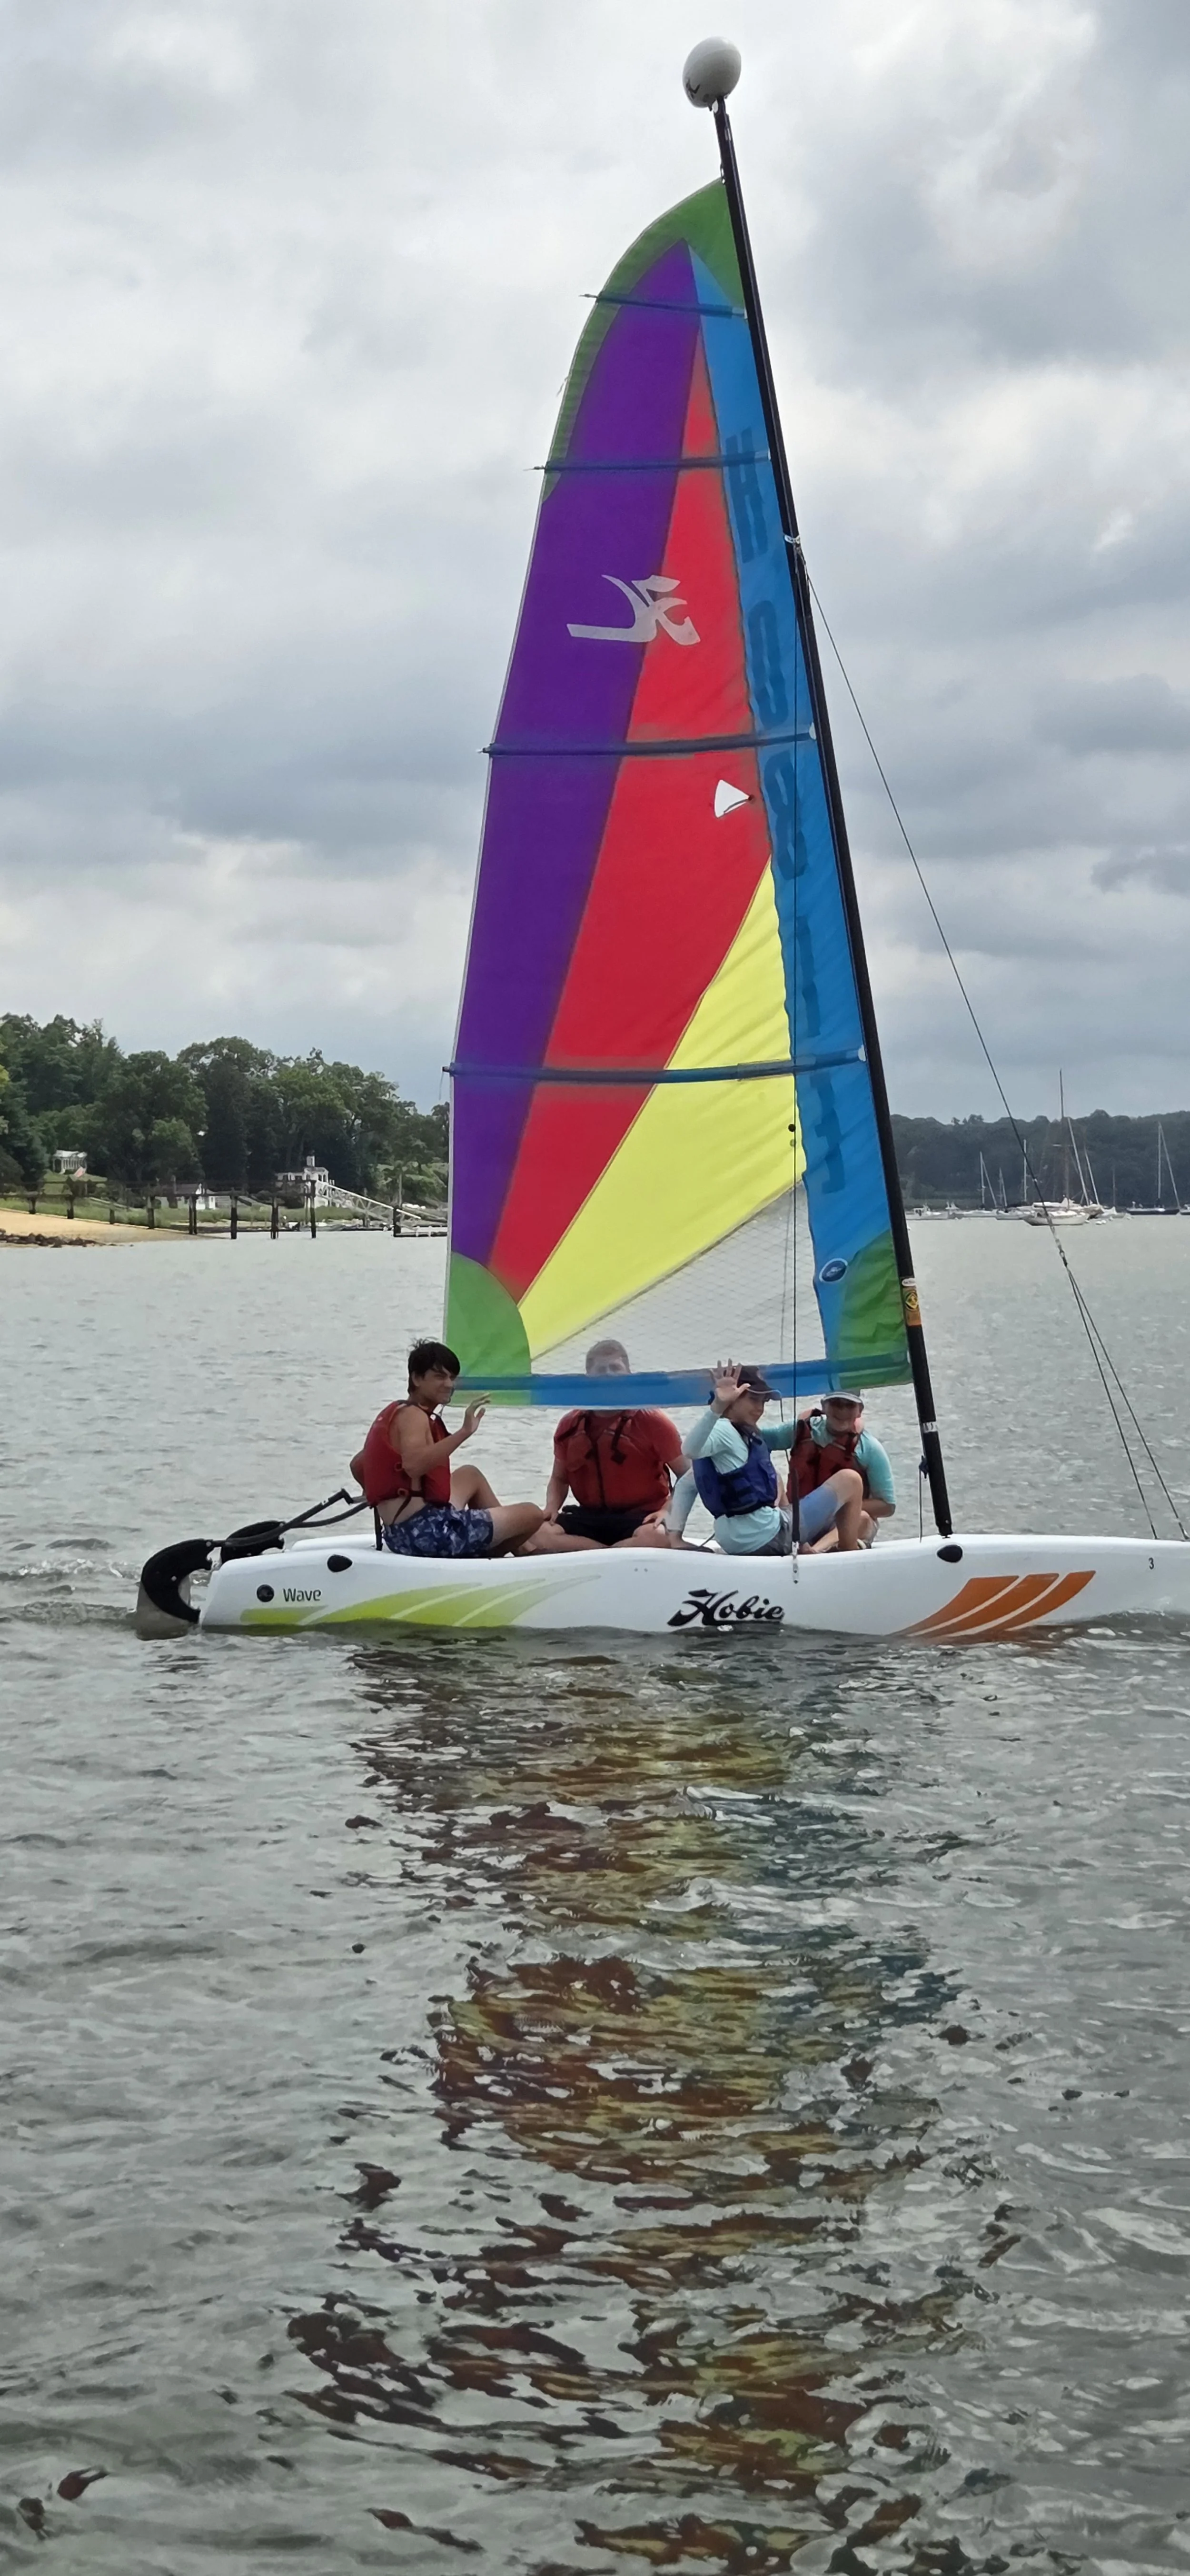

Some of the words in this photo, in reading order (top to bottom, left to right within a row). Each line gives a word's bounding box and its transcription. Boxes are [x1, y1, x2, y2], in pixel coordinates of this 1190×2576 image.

[1148, 1557, 1155, 1570] 3
[283, 1588, 322, 1602] Wave
[667, 1588, 785, 1626] Hobie
